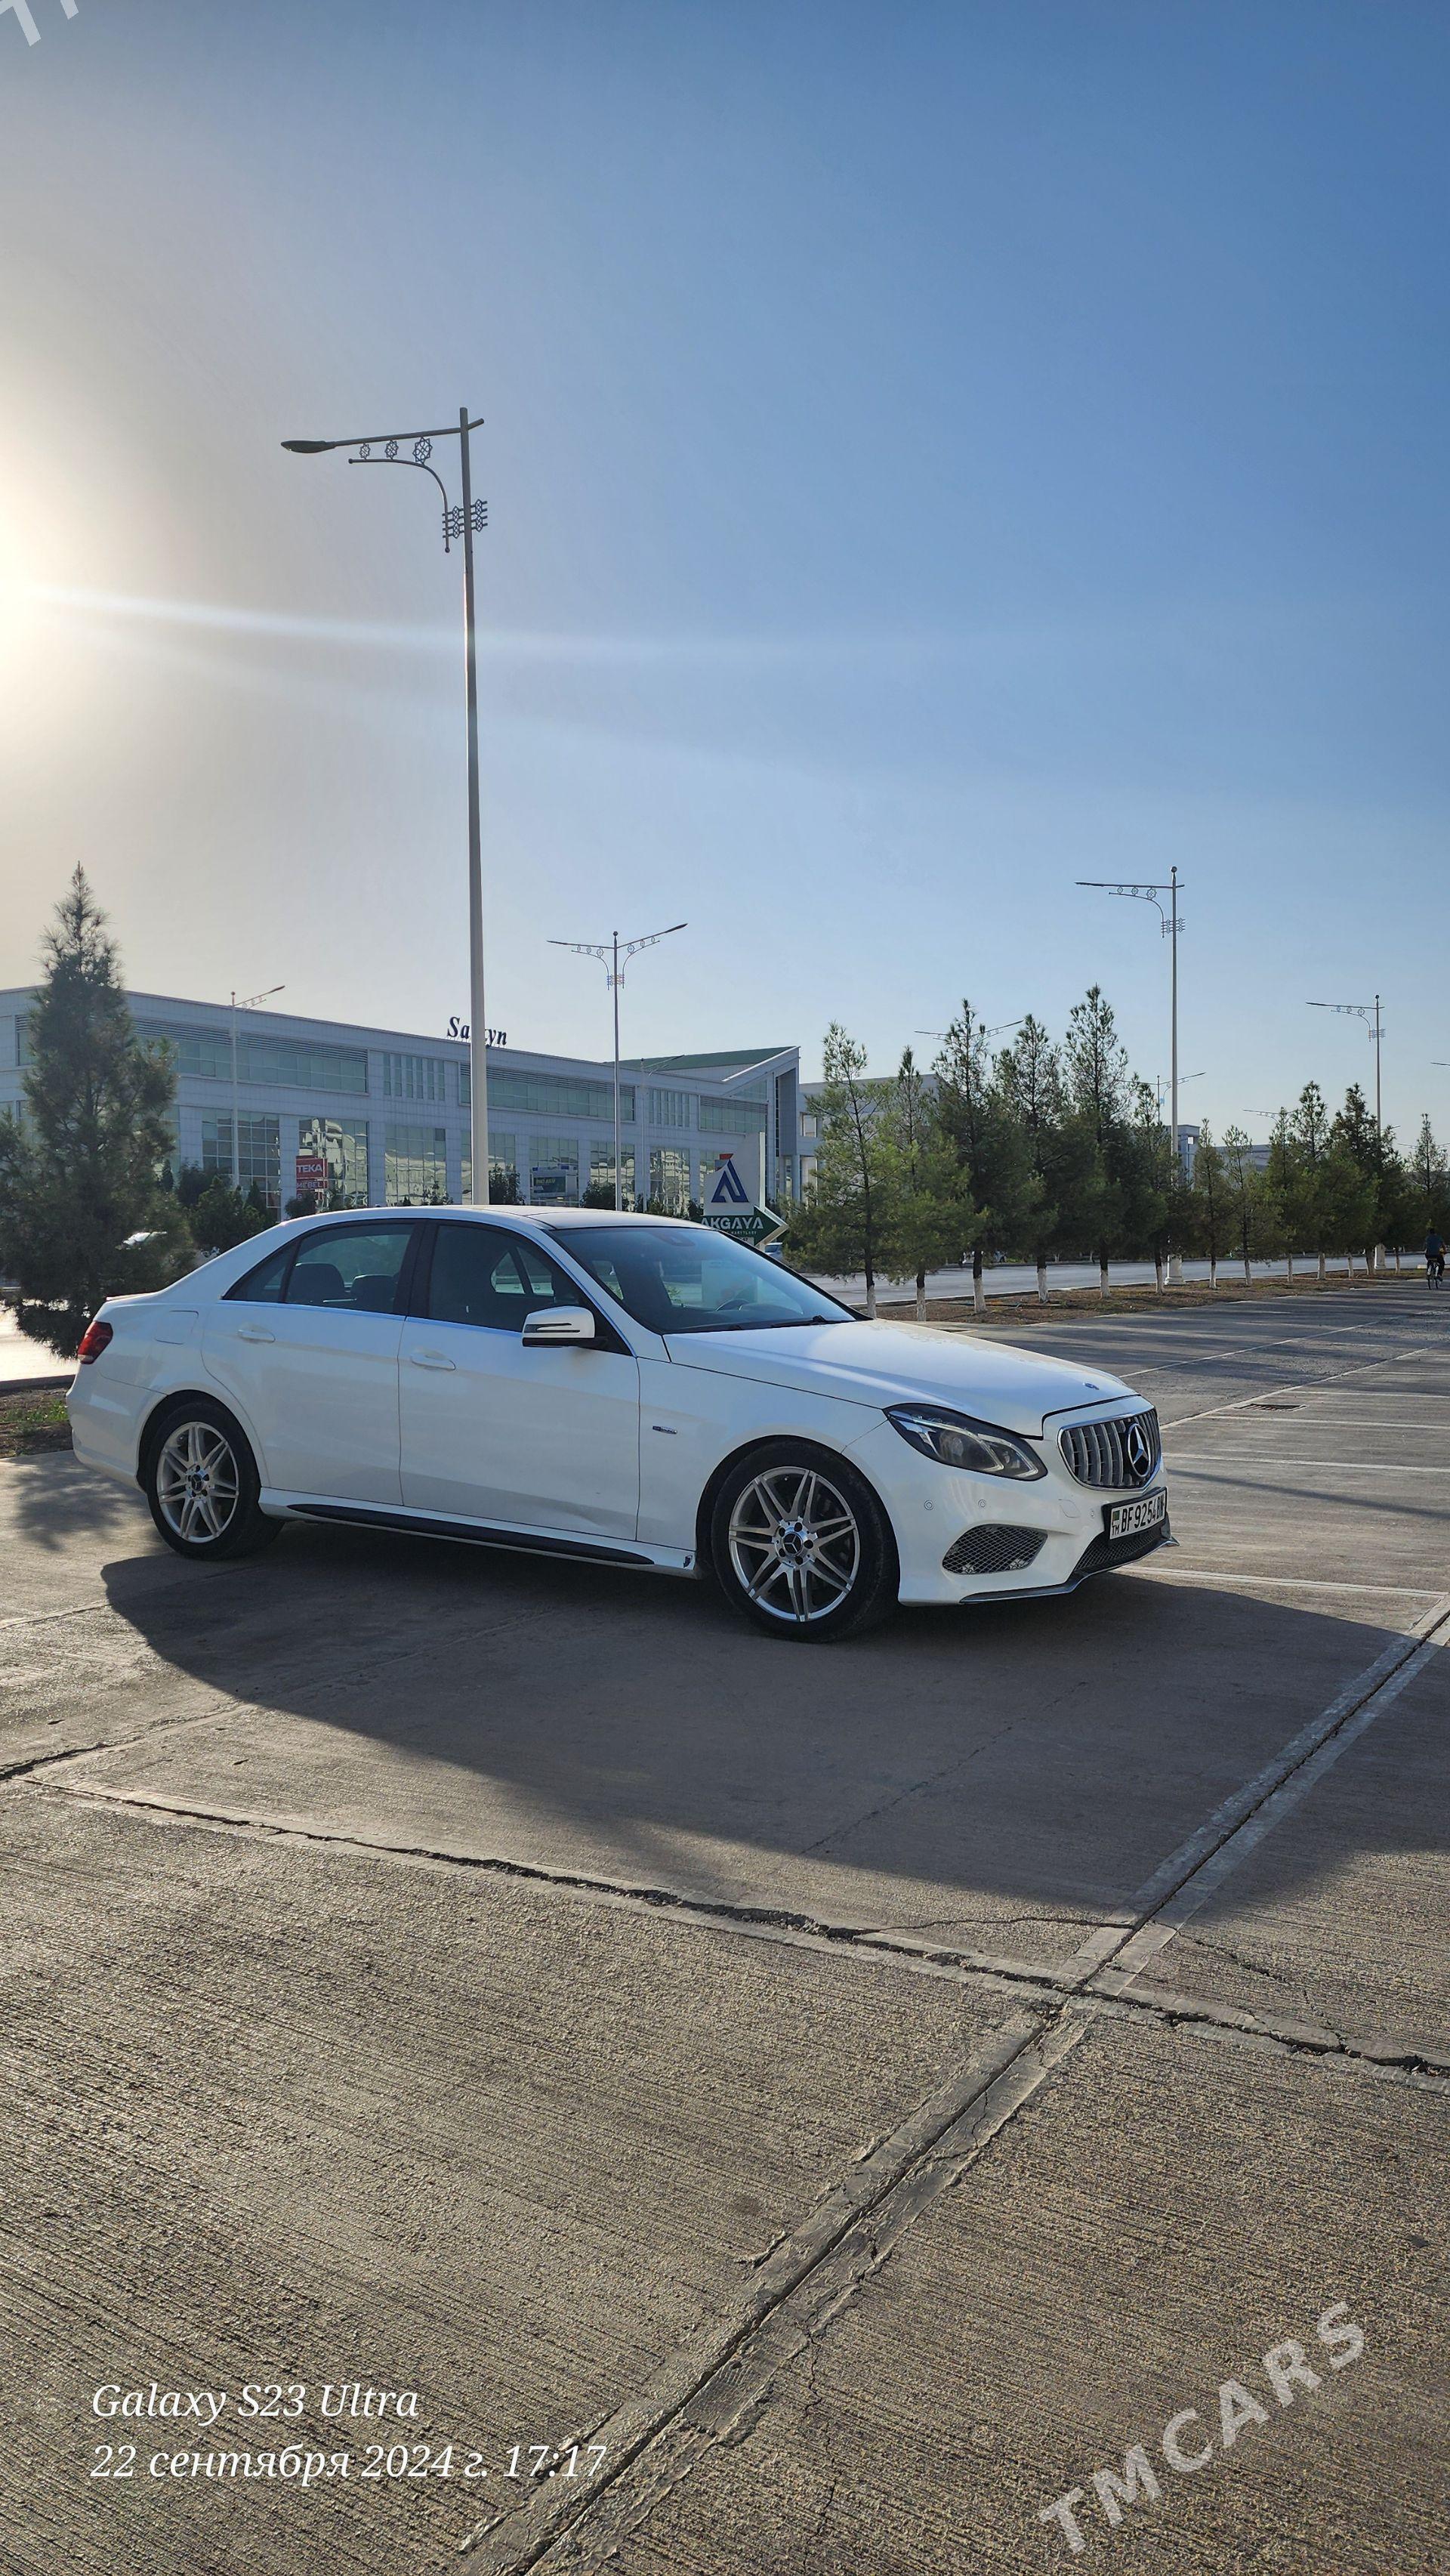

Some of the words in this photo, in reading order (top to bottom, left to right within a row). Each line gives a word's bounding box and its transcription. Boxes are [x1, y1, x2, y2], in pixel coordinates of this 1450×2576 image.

[447, 1016, 507, 1047] Sayn
[296, 1164, 322, 1173] TEKA
[700, 1217, 764, 1230] AKGAYA
